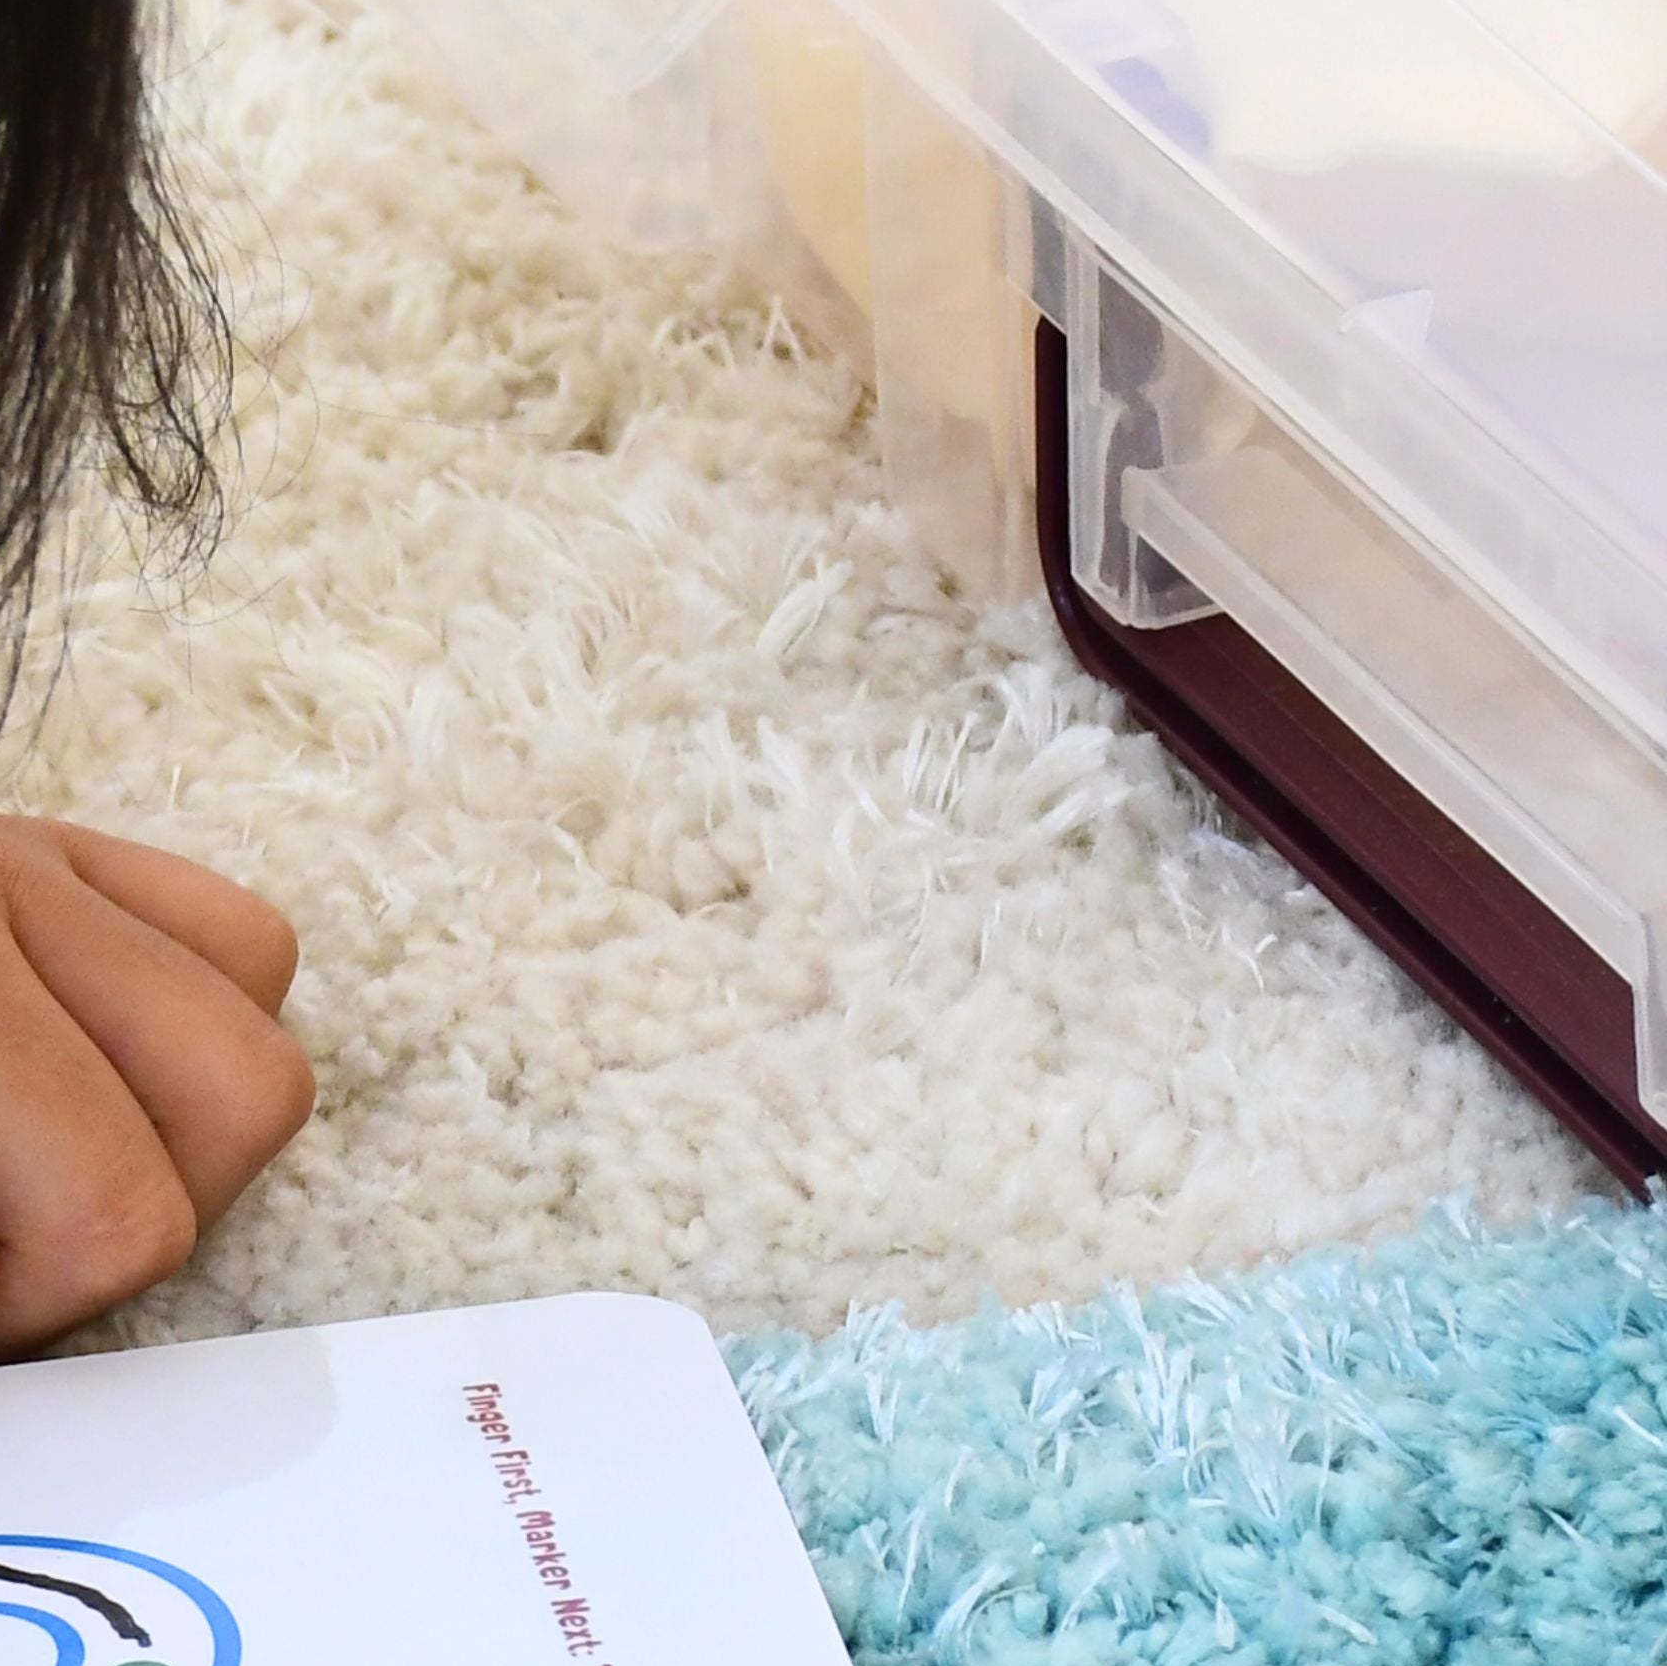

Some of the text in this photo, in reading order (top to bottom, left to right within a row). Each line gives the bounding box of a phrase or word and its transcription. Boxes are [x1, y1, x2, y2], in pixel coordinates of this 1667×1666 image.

[462, 1381, 511, 1444] Finger
[490, 1449, 542, 1505] First,
[515, 1509, 571, 1591] Marker
[551, 1596, 601, 1658] Next:
